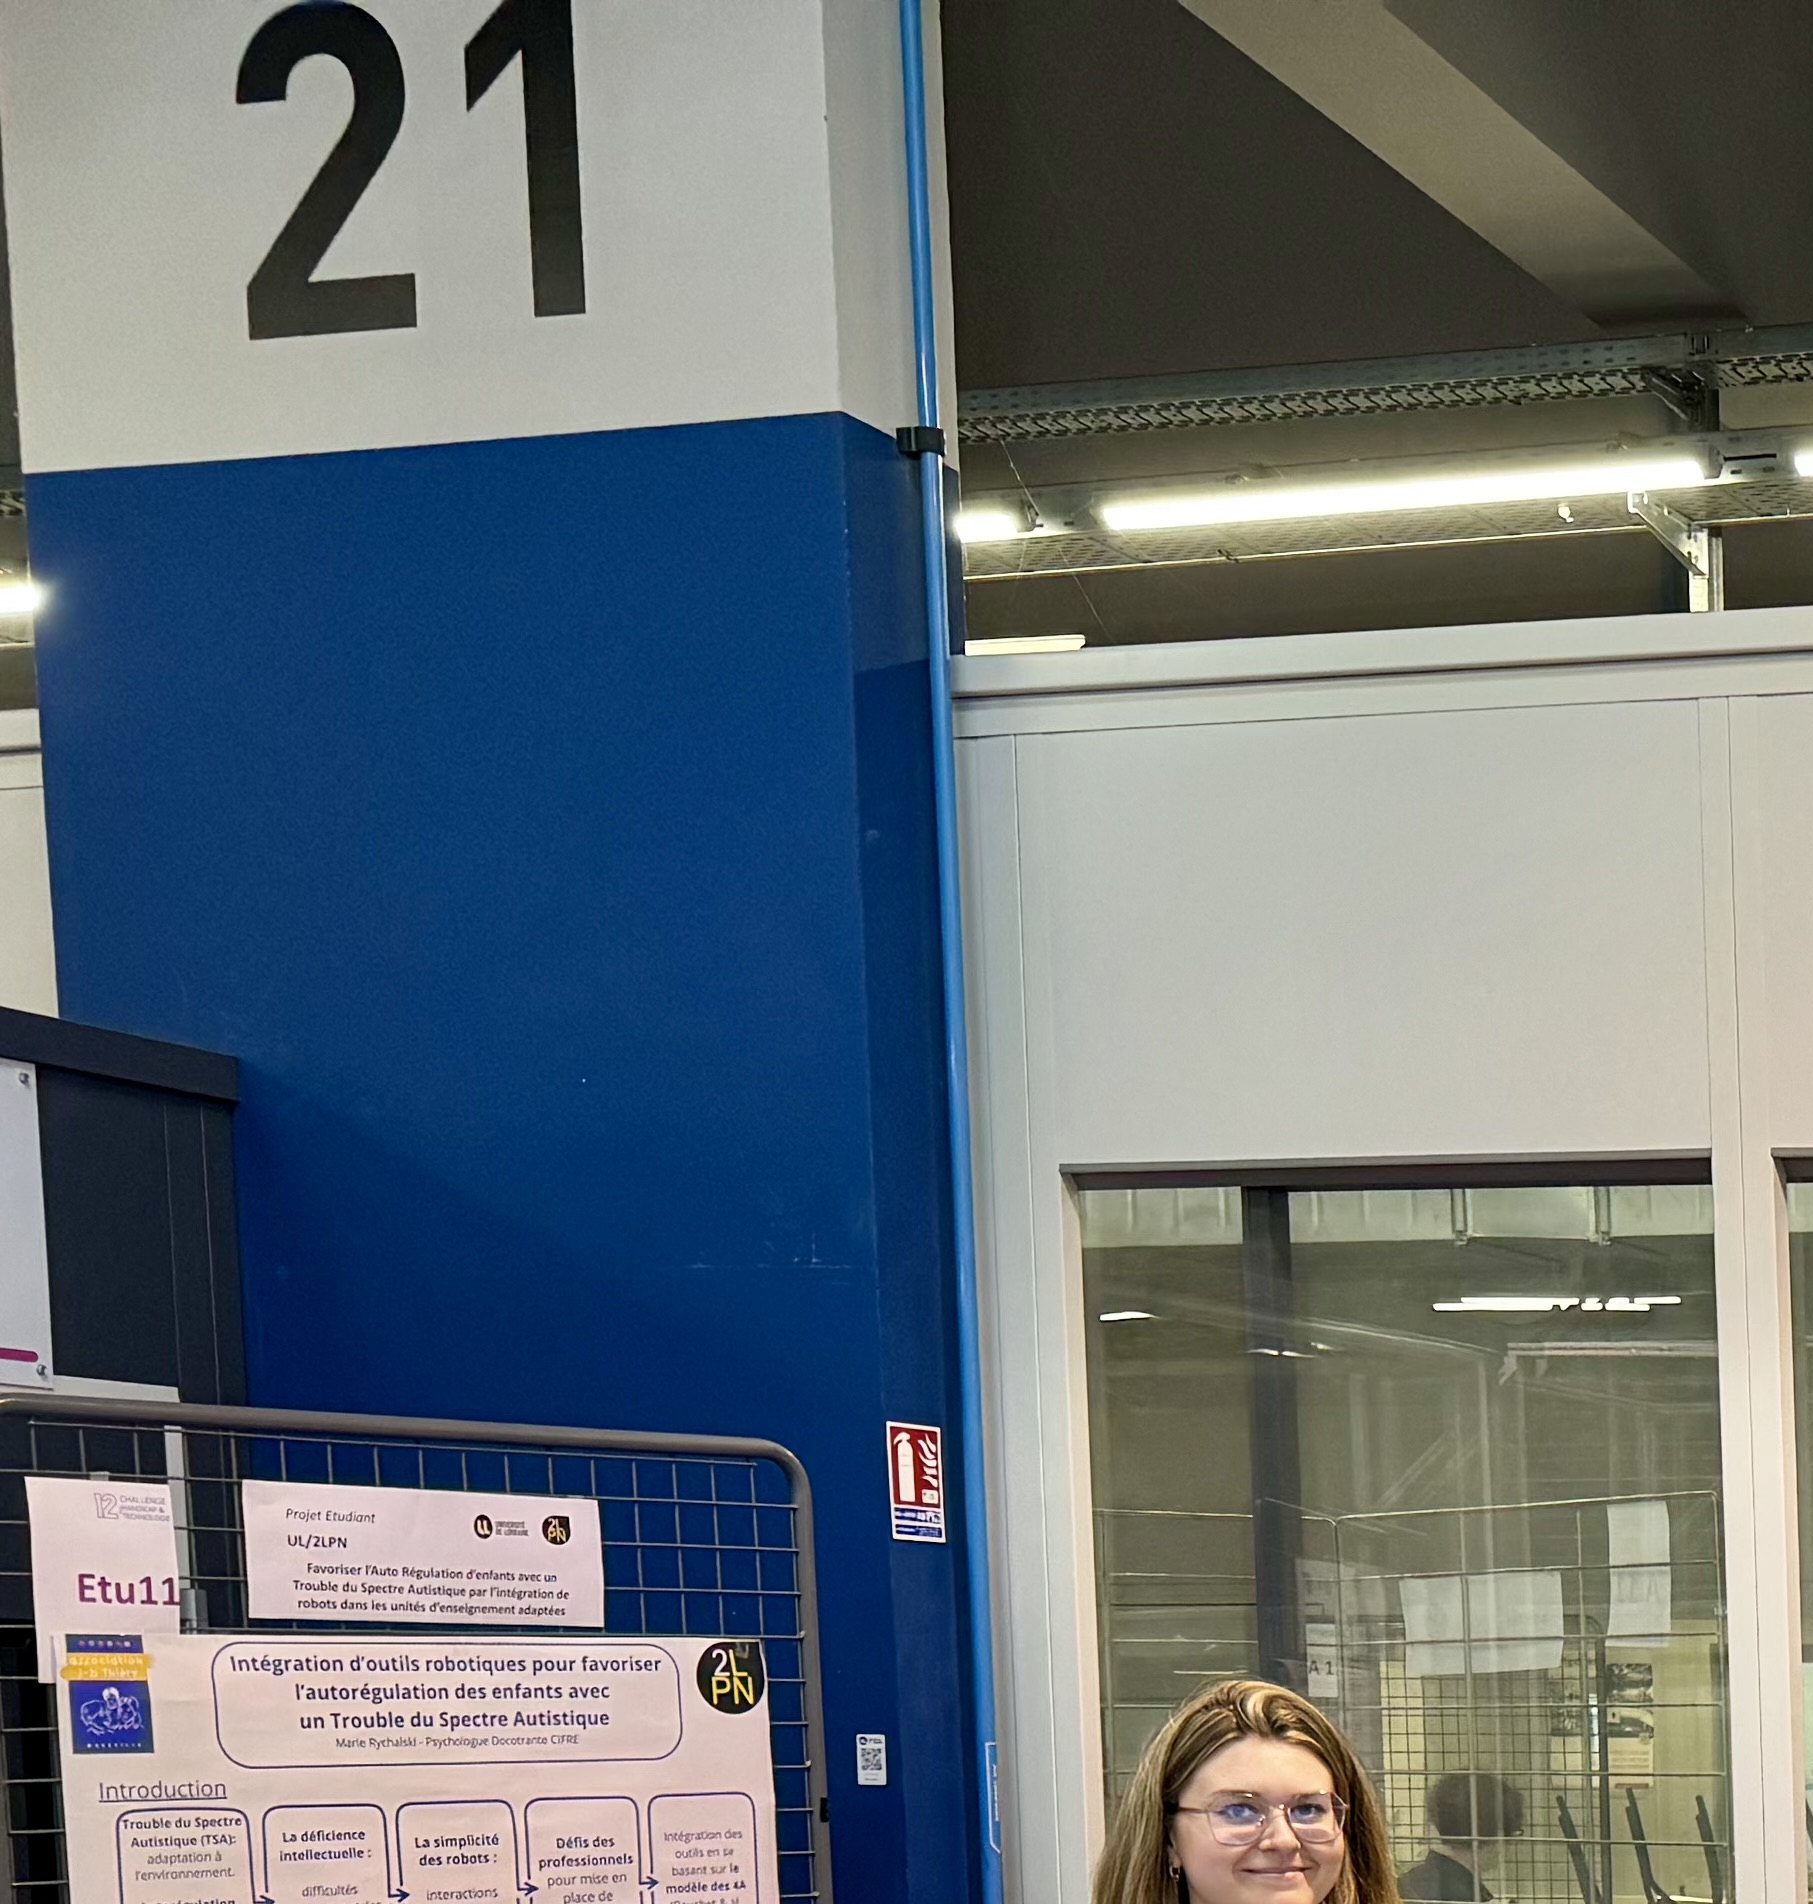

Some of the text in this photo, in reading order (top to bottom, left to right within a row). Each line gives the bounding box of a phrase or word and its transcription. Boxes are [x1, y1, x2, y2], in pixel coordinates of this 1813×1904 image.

[236, 0, 586, 340] 21
[286, 1509, 375, 1524] Projet Etudiant
[288, 1535, 348, 1549] UL/2LPN
[307, 1563, 362, 1576] Favoriser
[402, 1567, 463, 1580] Régulation
[466, 1569, 515, 1581] d'enfants
[518, 1572, 541, 1582] avec
[545, 1574, 557, 1582] un
[77, 1573, 180, 1606] Etu11
[293, 1581, 338, 1593] Trouble
[343, 1582, 357, 1593] du
[361, 1583, 404, 1596] Spectre
[408, 1585, 466, 1598] Autistique
[469, 1588, 487, 1599] par
[557, 1590, 569, 1599] de
[298, 1599, 337, 1609] robots
[341, 1600, 367, 1610] dans
[372, 1600, 387, 1610] les
[391, 1601, 425, 1612] unités
[518, 1605, 565, 1617] adaptées
[230, 1655, 662, 1676] Intégration d'outils robotiques pour favoriser
[711, 1648, 748, 1677] 2L
[295, 1683, 610, 1704] l'autorégulation des enfants avec
[711, 1676, 754, 1705] PN
[300, 1711, 610, 1731] un Trouble du Spectre Autistique
[99, 1781, 227, 1800] Introduction
[123, 1816, 242, 1829] Trouble du Spectre
[131, 1836, 197, 1850] Autistique
[283, 1831, 365, 1842] La déficience
[415, 1834, 499, 1848] La simplicité
[556, 1836, 615, 1849] Défis des
[420, 1853, 489, 1865] des robots
[539, 1854, 633, 1871] professionnels
